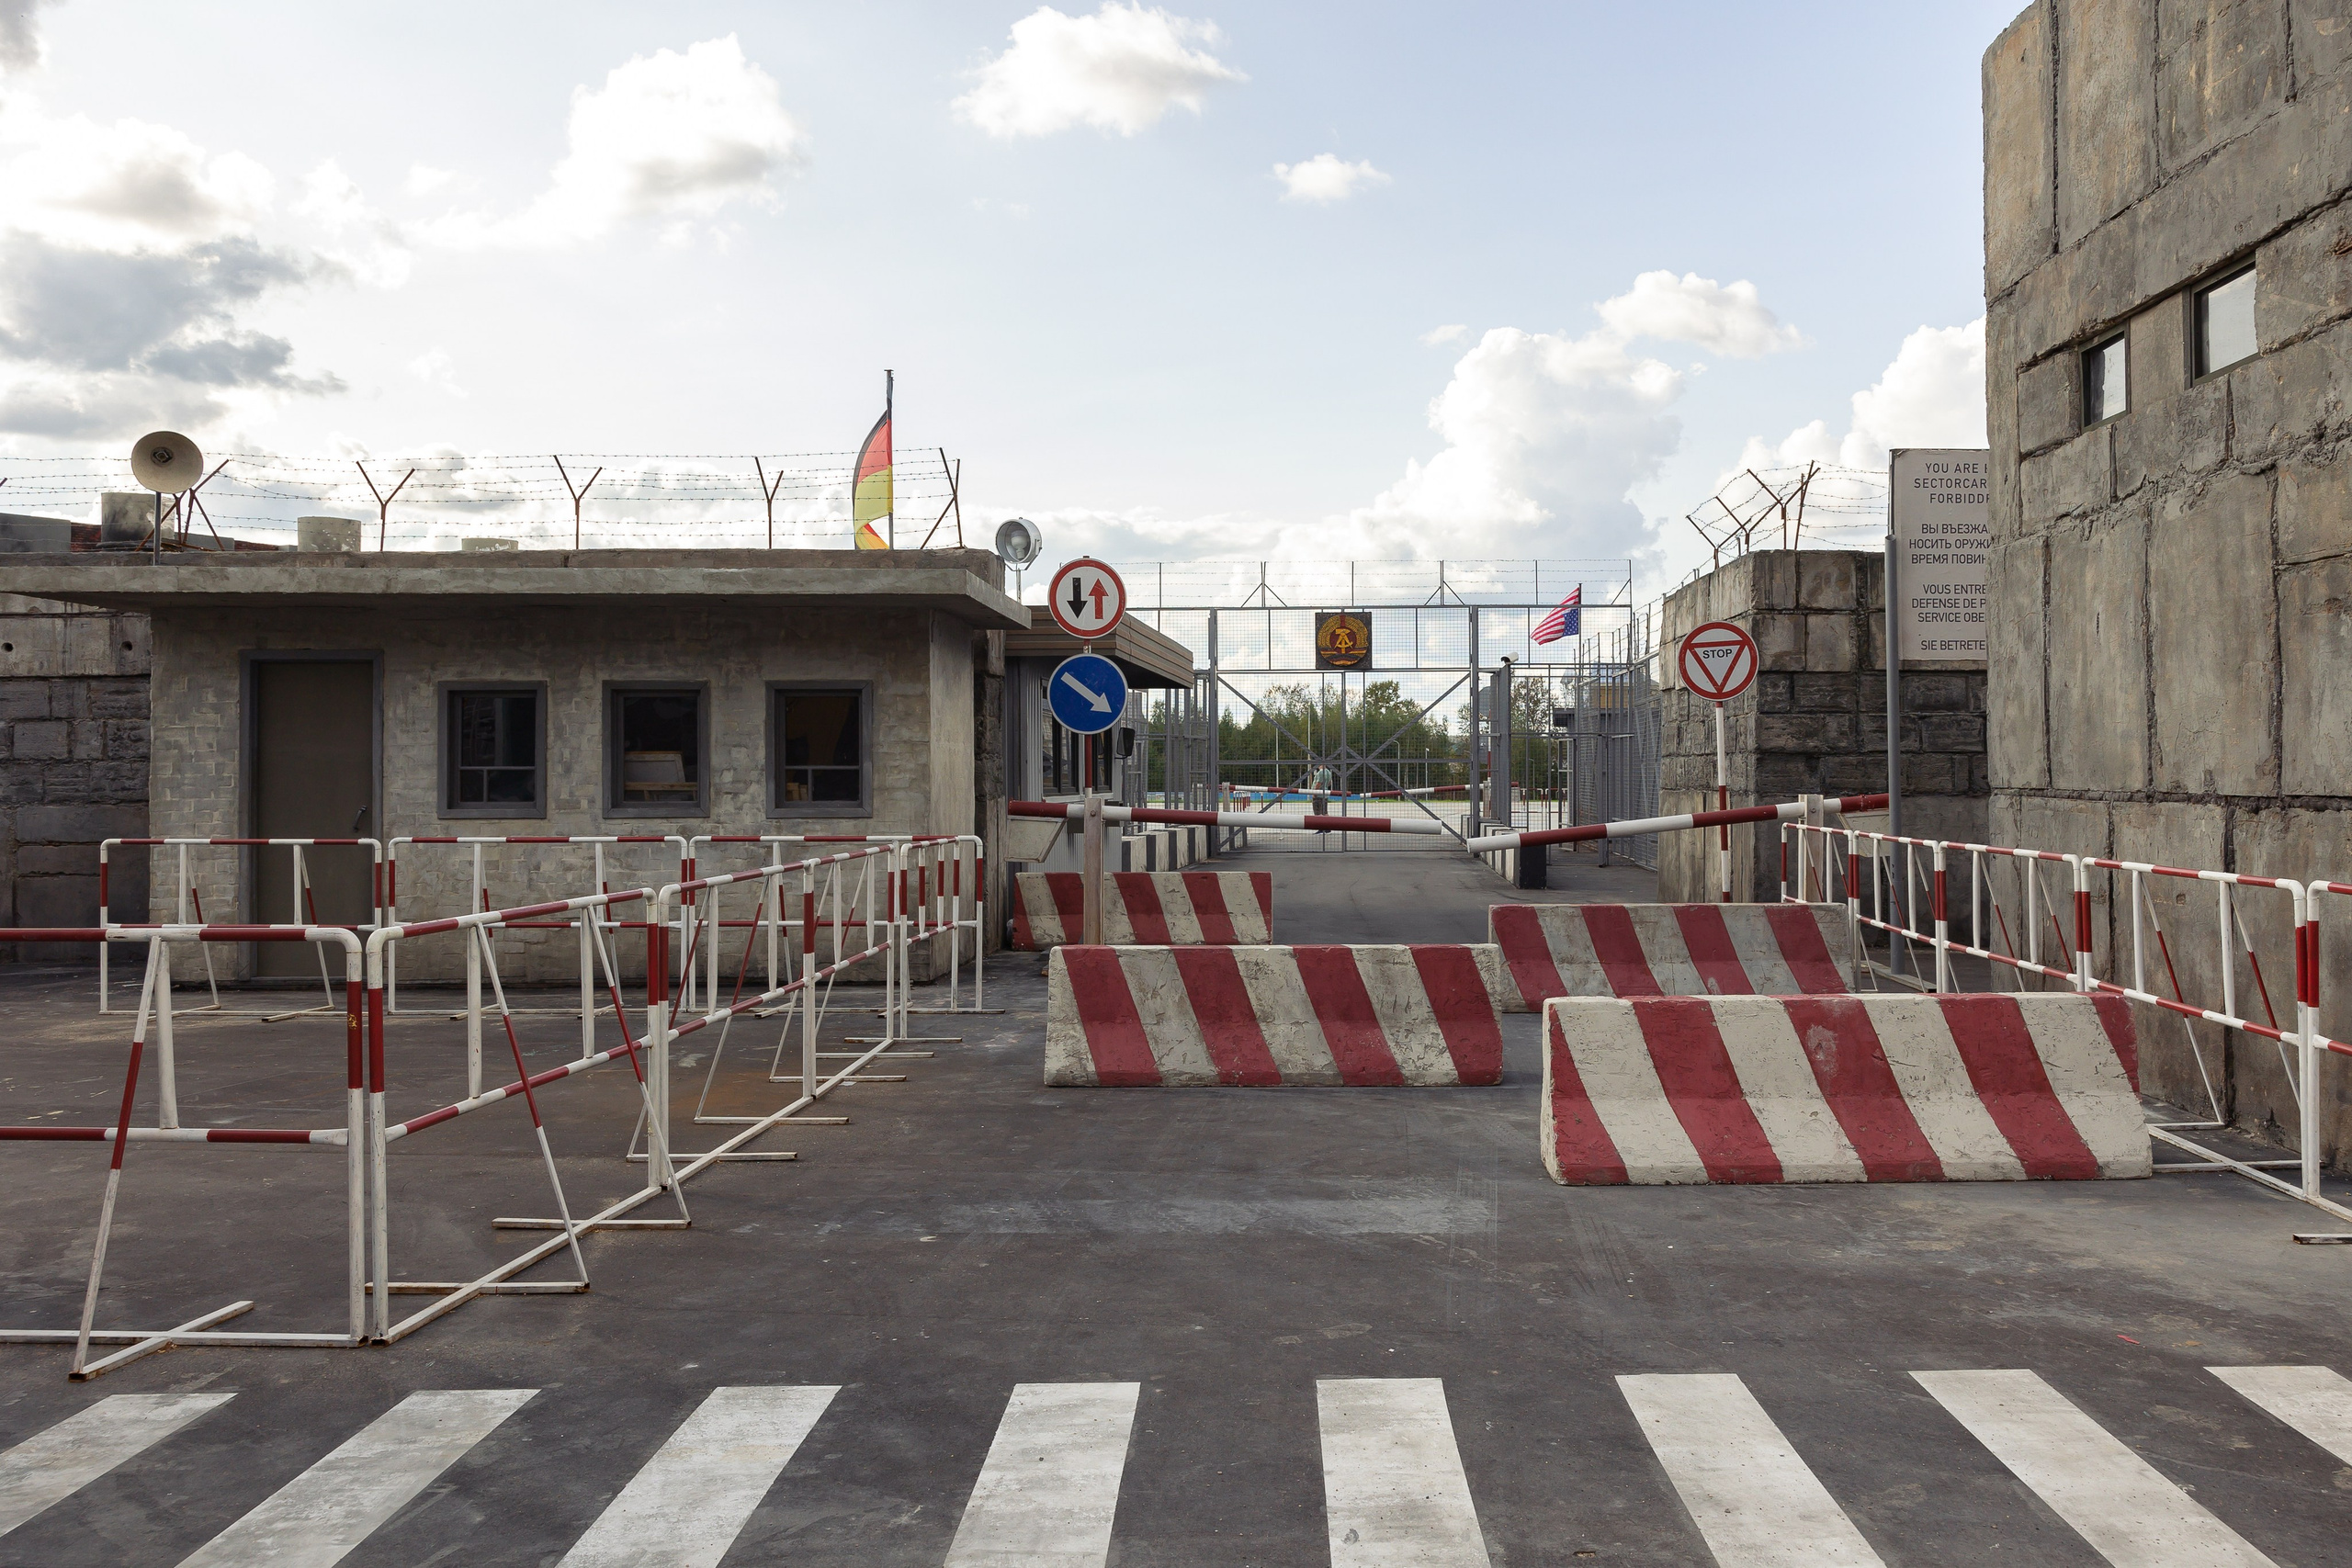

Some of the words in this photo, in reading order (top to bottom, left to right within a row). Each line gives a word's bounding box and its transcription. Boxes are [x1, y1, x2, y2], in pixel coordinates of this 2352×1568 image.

[1926, 463, 1949, 473] YOU
[1954, 463, 1979, 473] ARE
[1914, 478, 1987, 489] SECTORCAR
[1921, 524, 1939, 534] ВЫ
[1941, 524, 1990, 534] ВЪЕЗЖА
[1909, 538, 1951, 549] НОСИТЬ
[1911, 554, 1948, 564] ВРЕМЯ
[1923, 584, 1951, 594] VOUS
[1912, 598, 1961, 609] DEFENSE
[1962, 598, 1977, 609] DE
[1917, 612, 1962, 623] SERVICE
[1963, 612, 1985, 623] OBE
[1921, 640, 1938, 650] SIE
[1940, 640, 1986, 650] BETRETE
[1702, 649, 1733, 660] STOP
